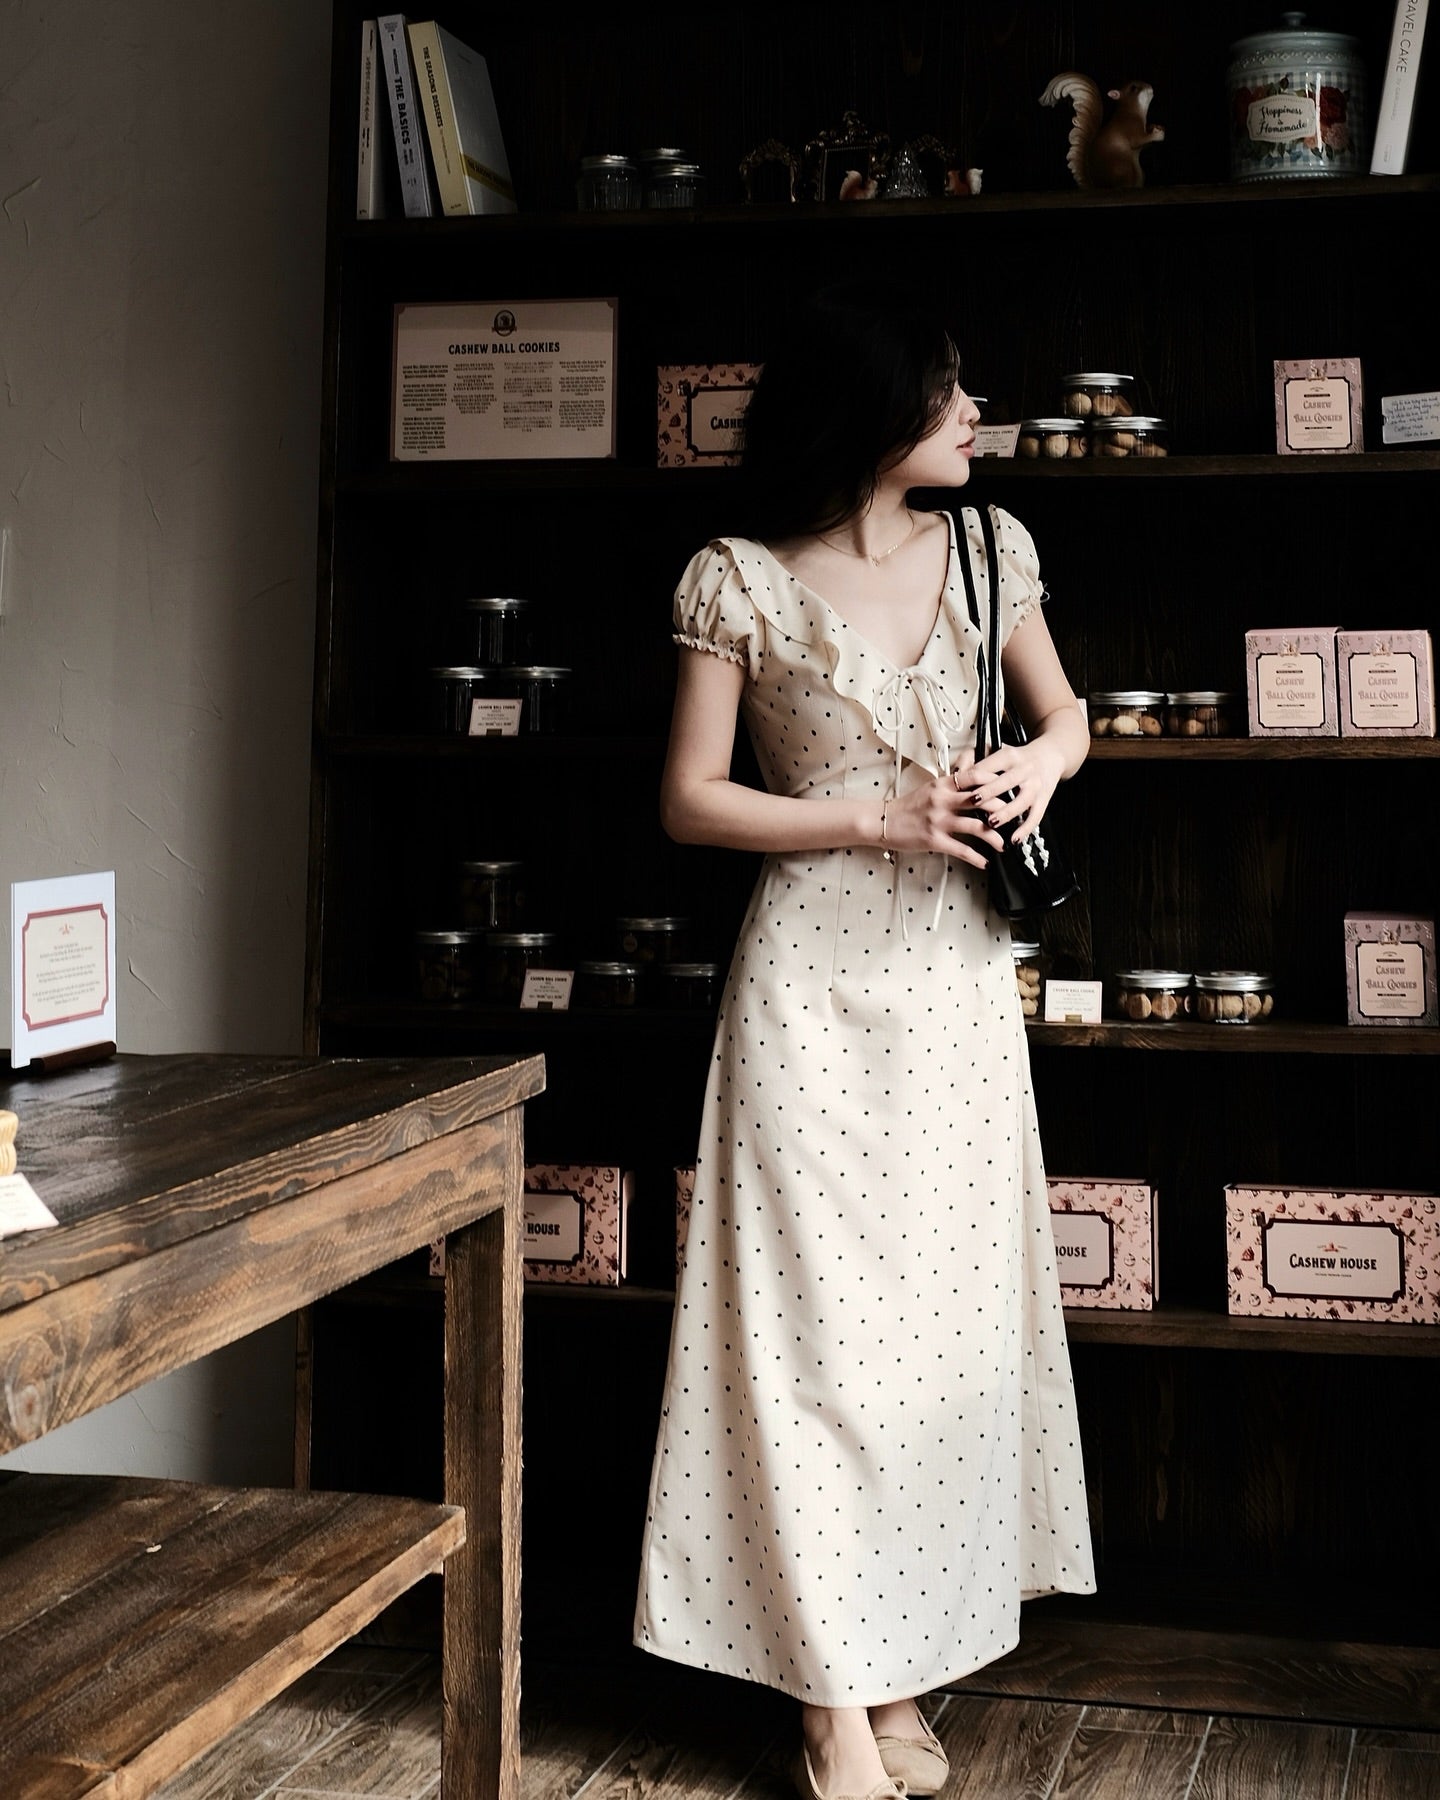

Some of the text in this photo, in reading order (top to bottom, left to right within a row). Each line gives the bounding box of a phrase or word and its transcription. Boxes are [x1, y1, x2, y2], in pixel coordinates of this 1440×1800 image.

[1395, 39, 1411, 73] CAKE
[394, 77, 405, 100] THE
[423, 46, 444, 127] THE SEASONS DESSERTS
[1259, 105, 1303, 119] Happiness
[397, 103, 410, 145] BASICS
[1257, 120, 1307, 136] Homemade
[448, 342, 561, 355] CASHEW BALL COOKIES
[710, 415, 744, 431] CASHE
[1274, 675, 1305, 686] CASHEW
[1367, 675, 1398, 686] CASHEW
[1265, 689, 1316, 702] BALL COOKIES
[1358, 689, 1409, 702] BALL COOKIES
[1375, 965, 1406, 976] CASHEW
[1365, 978, 1418, 991] BALL COOKIES
[527, 1223, 560, 1236] HOUSE
[1289, 1253, 1377, 1271] CASHEW HOUSE
